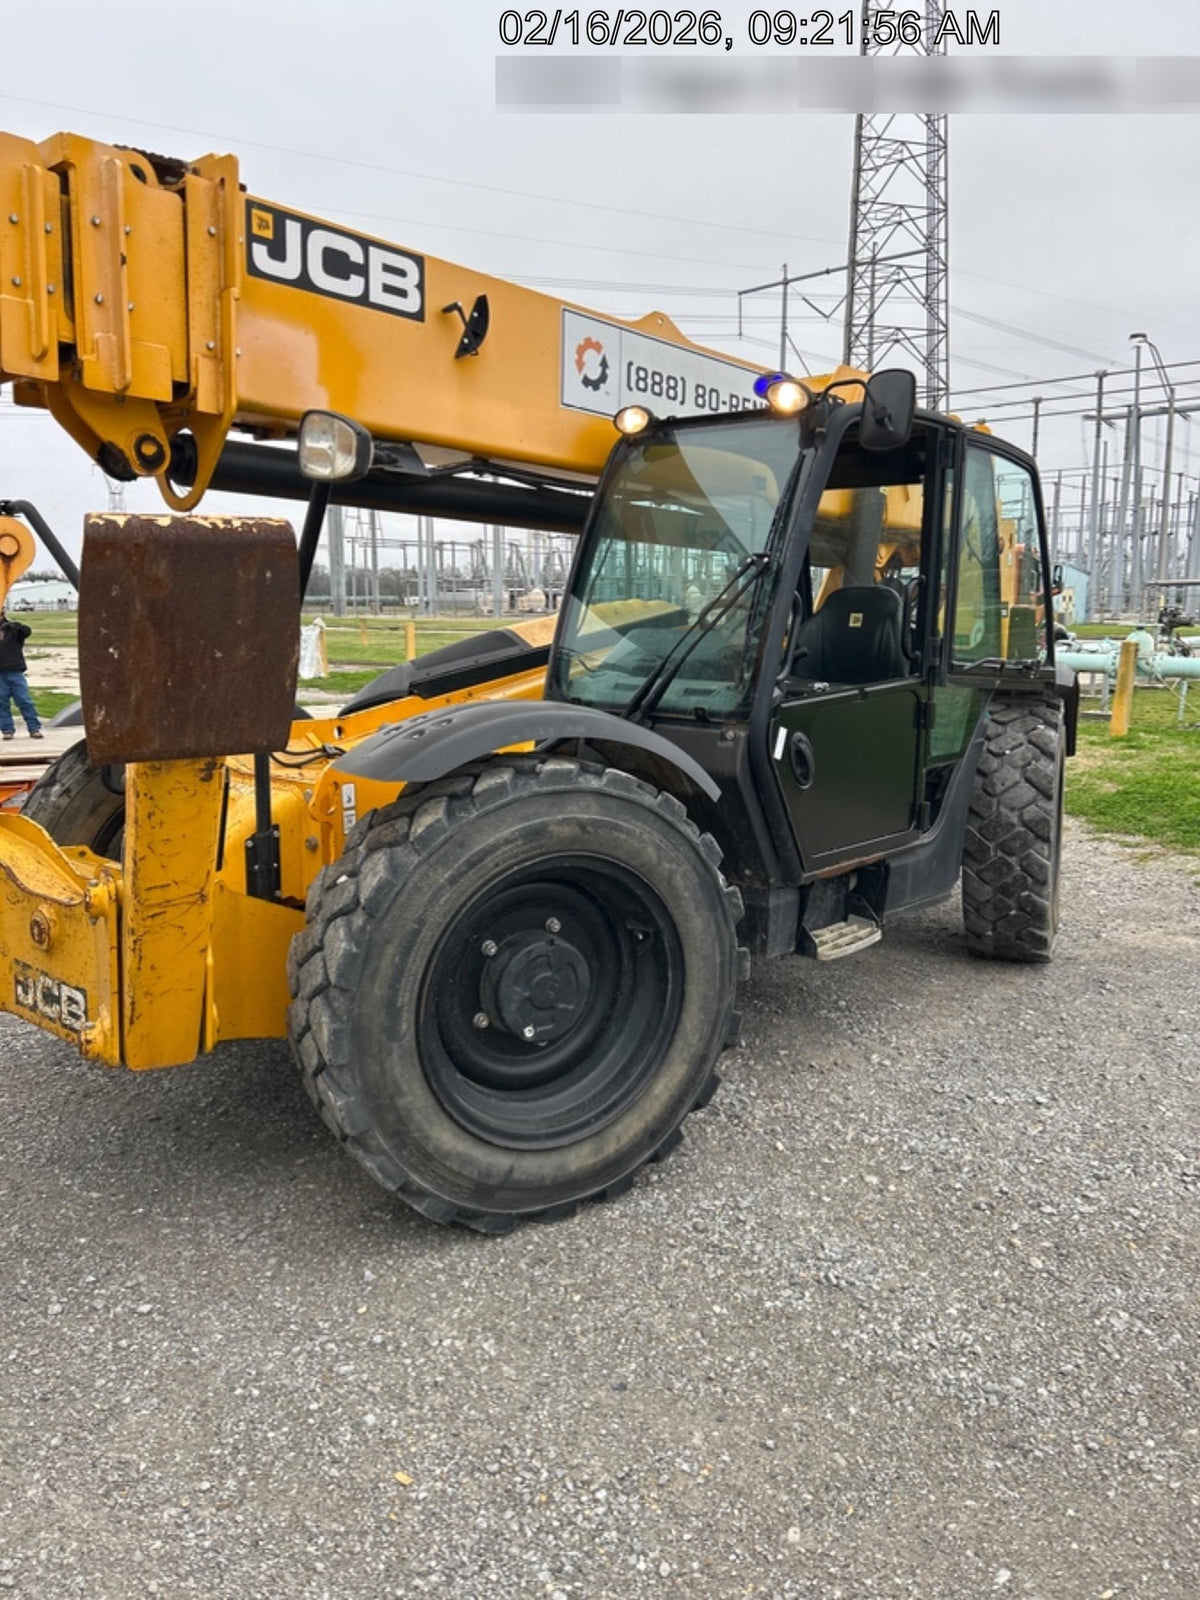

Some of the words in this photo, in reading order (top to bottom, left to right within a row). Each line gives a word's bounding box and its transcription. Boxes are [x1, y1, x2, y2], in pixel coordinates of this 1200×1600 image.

[251, 218, 422, 314] JCB
[627, 360, 687, 406] (888)
[16, 975, 87, 1031] JCB
